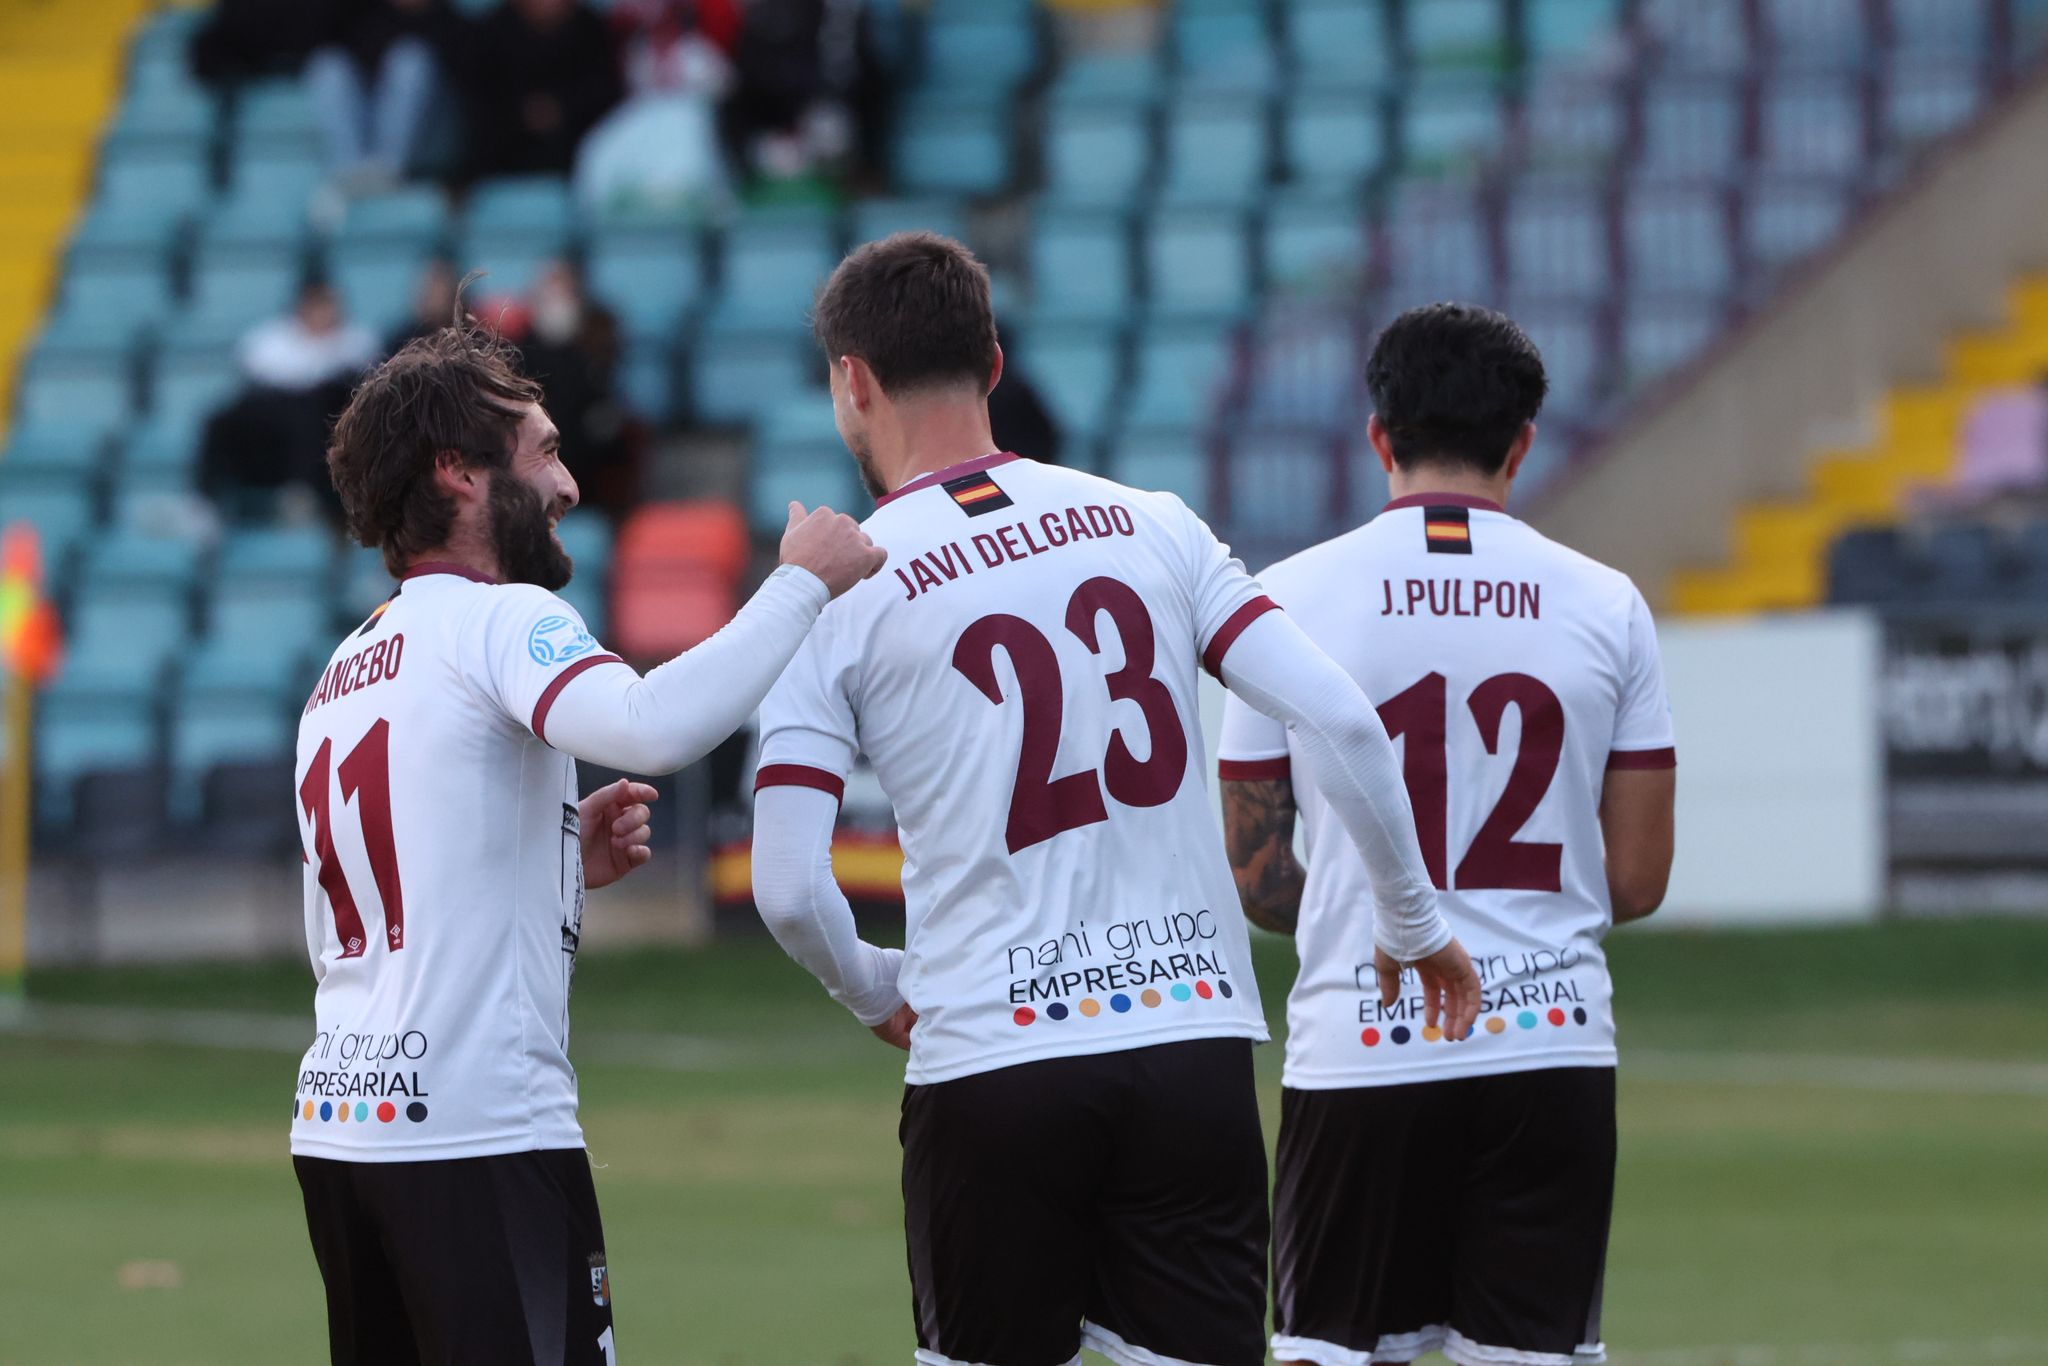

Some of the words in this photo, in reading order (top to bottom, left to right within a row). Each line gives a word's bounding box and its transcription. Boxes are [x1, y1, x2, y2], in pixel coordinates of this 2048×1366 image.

[894, 541, 974, 602] JAVI
[971, 504, 1135, 569] DELGADO
[1381, 578, 1540, 620] J.PULPON
[952, 575, 1187, 856] 23
[1375, 670, 1565, 893] 12
[299, 716, 404, 960] 11
[1008, 920, 1092, 974] nani
[1106, 909, 1217, 961] grupo
[1009, 950, 1227, 1004] EMPRESARIAL
[1359, 979, 1585, 1023] EMPSARIAL
[339, 1030, 428, 1070] grupo
[297, 1070, 429, 1097] MPRESARIAL
